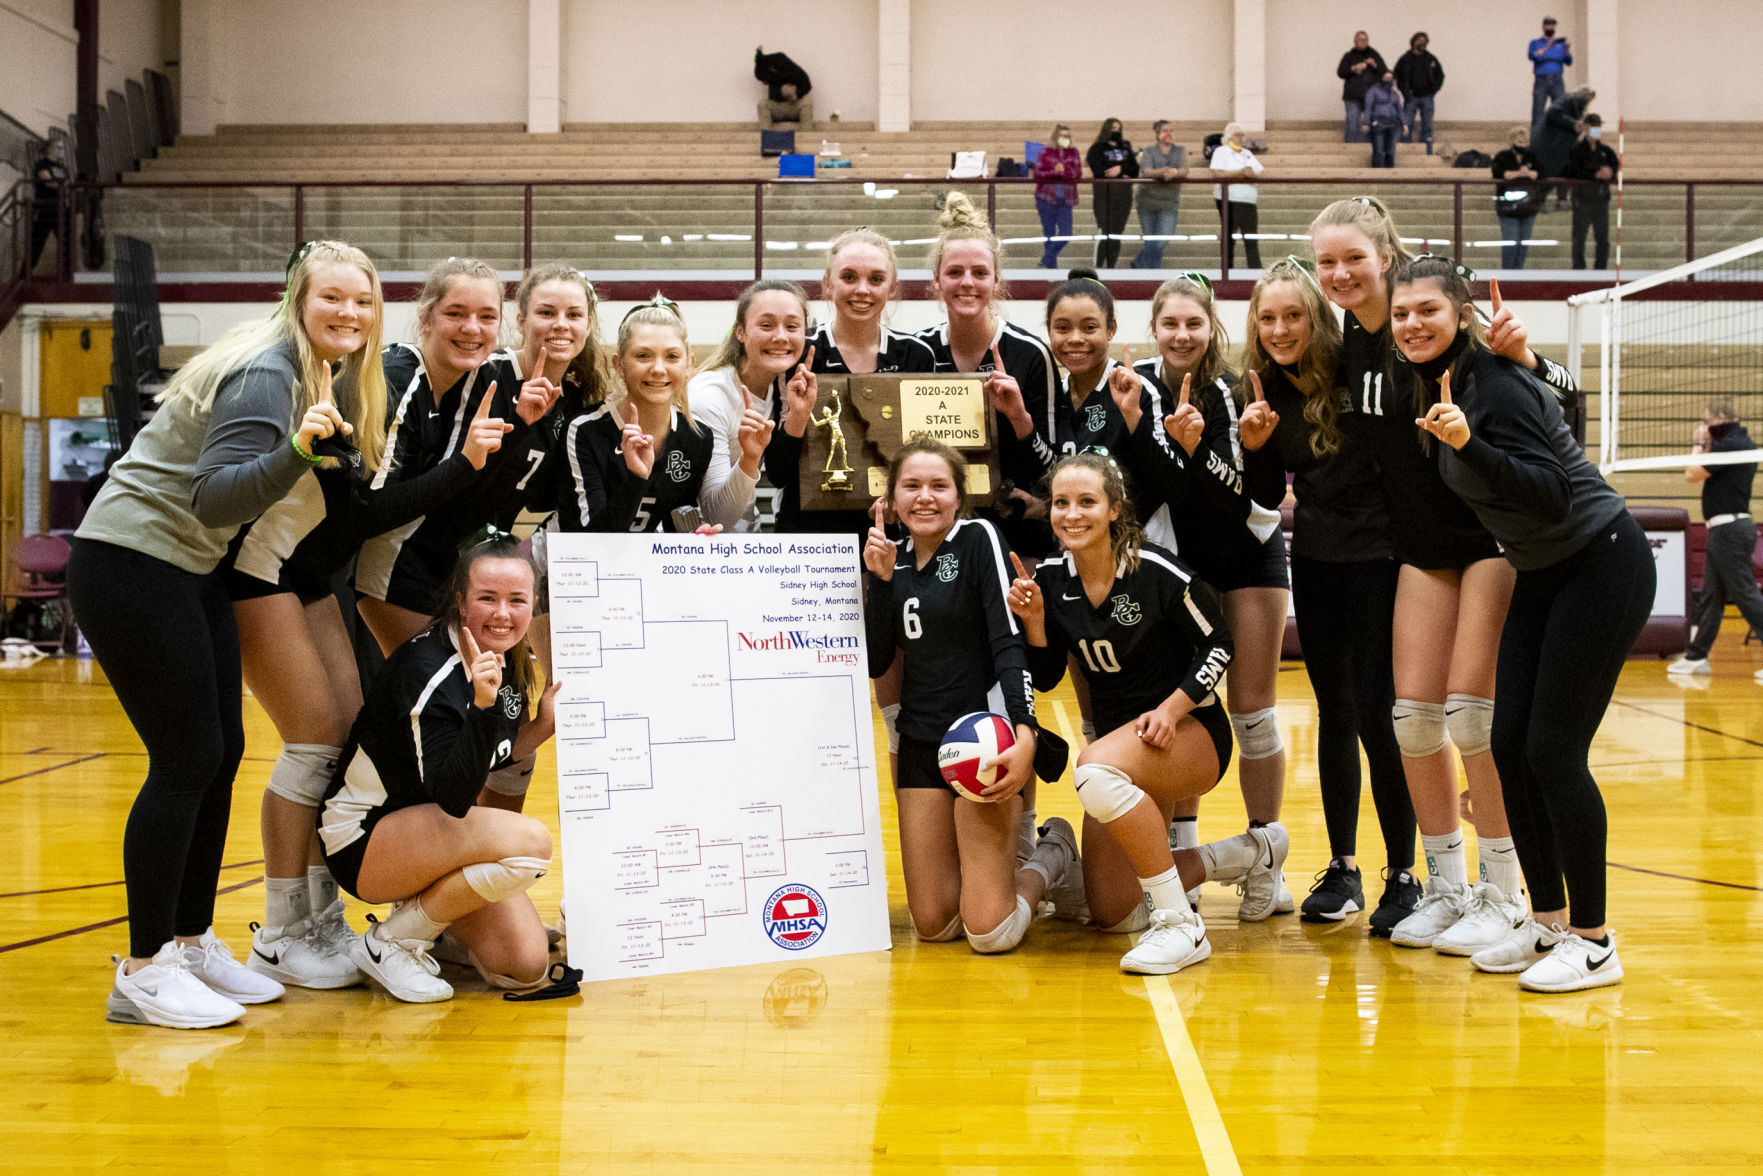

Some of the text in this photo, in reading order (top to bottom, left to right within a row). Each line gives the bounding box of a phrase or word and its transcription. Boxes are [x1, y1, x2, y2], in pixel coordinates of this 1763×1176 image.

[915, 386, 969, 396] 2020-2021
[1362, 371, 1384, 416] 11
[938, 401, 946, 410] A
[926, 415, 962, 425] STATE
[515, 448, 546, 491] 7
[629, 497, 657, 533] 5
[652, 543, 854, 557] Montana High School Association
[663, 566, 686, 574] 2020
[690, 566, 716, 574] State
[720, 566, 743, 574] Class
[759, 565, 800, 575] Volleyball
[805, 565, 855, 573] Tournament
[780, 580, 857, 590] Sidney High School
[792, 596, 859, 607] Sidney, Montana
[839, 612, 860, 622] 2020
[903, 597, 923, 640] 6
[737, 631, 859, 651] NorthWestern
[817, 650, 860, 667] Energy
[1078, 638, 1122, 673] 10
[766, 886, 824, 923] MONTANA HIGH SCHOOL
[769, 918, 825, 937] MHSA
[775, 932, 819, 948] ASSOCIATION
